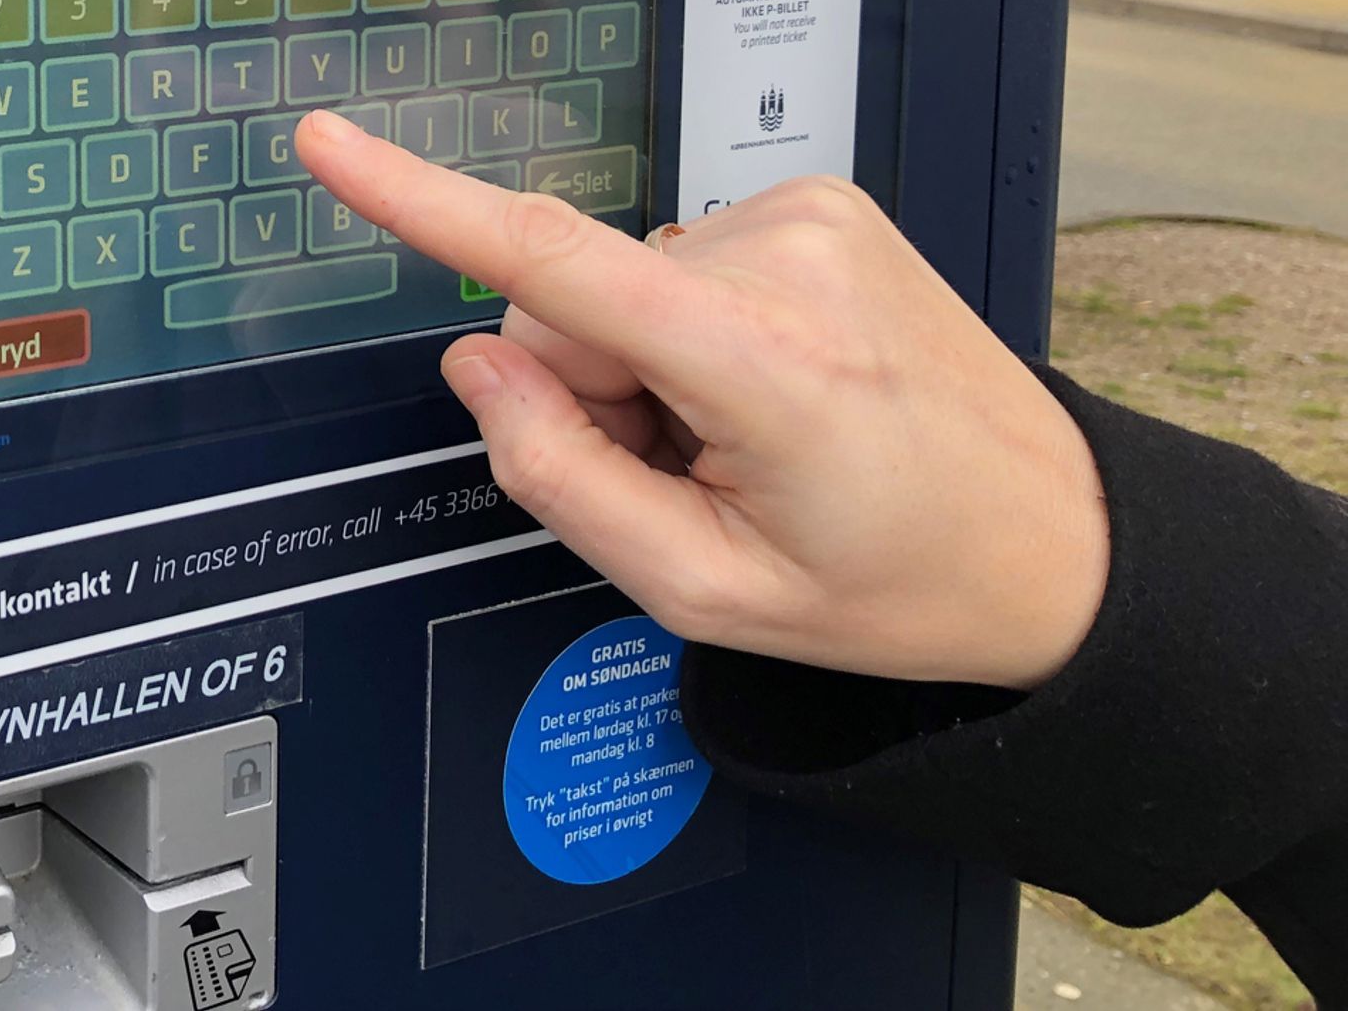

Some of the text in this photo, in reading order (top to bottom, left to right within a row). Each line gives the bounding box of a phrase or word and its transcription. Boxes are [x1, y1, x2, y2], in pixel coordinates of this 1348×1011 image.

[733, 15, 817, 34] You will not receive
[741, 0, 810, 18] IKKE P-BILLET
[748, 34, 781, 50] printed
[783, 31, 808, 45] ticket
[71, 77, 89, 108] E
[152, 69, 173, 100] R
[233, 61, 252, 90] T
[311, 52, 331, 82] Y
[386, 45, 405, 75] U
[464, 38, 472, 66] I
[530, 30, 549, 60] O
[599, 24, 617, 52] P
[27, 162, 46, 195] S
[110, 153, 131, 184] D
[192, 143, 210, 174] F
[269, 134, 288, 164] G
[424, 117, 434, 151] J
[492, 108, 511, 136] K
[563, 101, 578, 128] L
[572, 169, 613, 196] Slet
[12, 204, 351, 277] Z X C V B
[0, 568, 111, 620] kontakt
[152, 554, 176, 584] in
[183, 543, 237, 577] case
[244, 530, 273, 567] of
[276, 523, 333, 555] error,
[342, 506, 383, 541] call
[394, 494, 438, 526] +45
[443, 482, 499, 518] 3366
[200, 651, 259, 698] OF
[263, 643, 288, 683] 6
[592, 637, 646, 664] GRATIS
[563, 653, 671, 692] OM SØNDAGEN
[540, 712, 564, 732] Det
[567, 709, 580, 725] er
[583, 700, 622, 724] gratis
[624, 695, 638, 711] at
[540, 728, 590, 754] mellem
[593, 719, 634, 741] lørdag
[636, 712, 652, 730] kl.
[655, 708, 669, 725] 17
[571, 732, 655, 768] mandag kl. 8
[525, 793, 556, 813] Tryk
[612, 773, 630, 793] på
[633, 757, 694, 785] skærmen
[545, 784, 673, 829] for information om
[564, 823, 603, 849] priser
[613, 808, 654, 832] øvrigt
